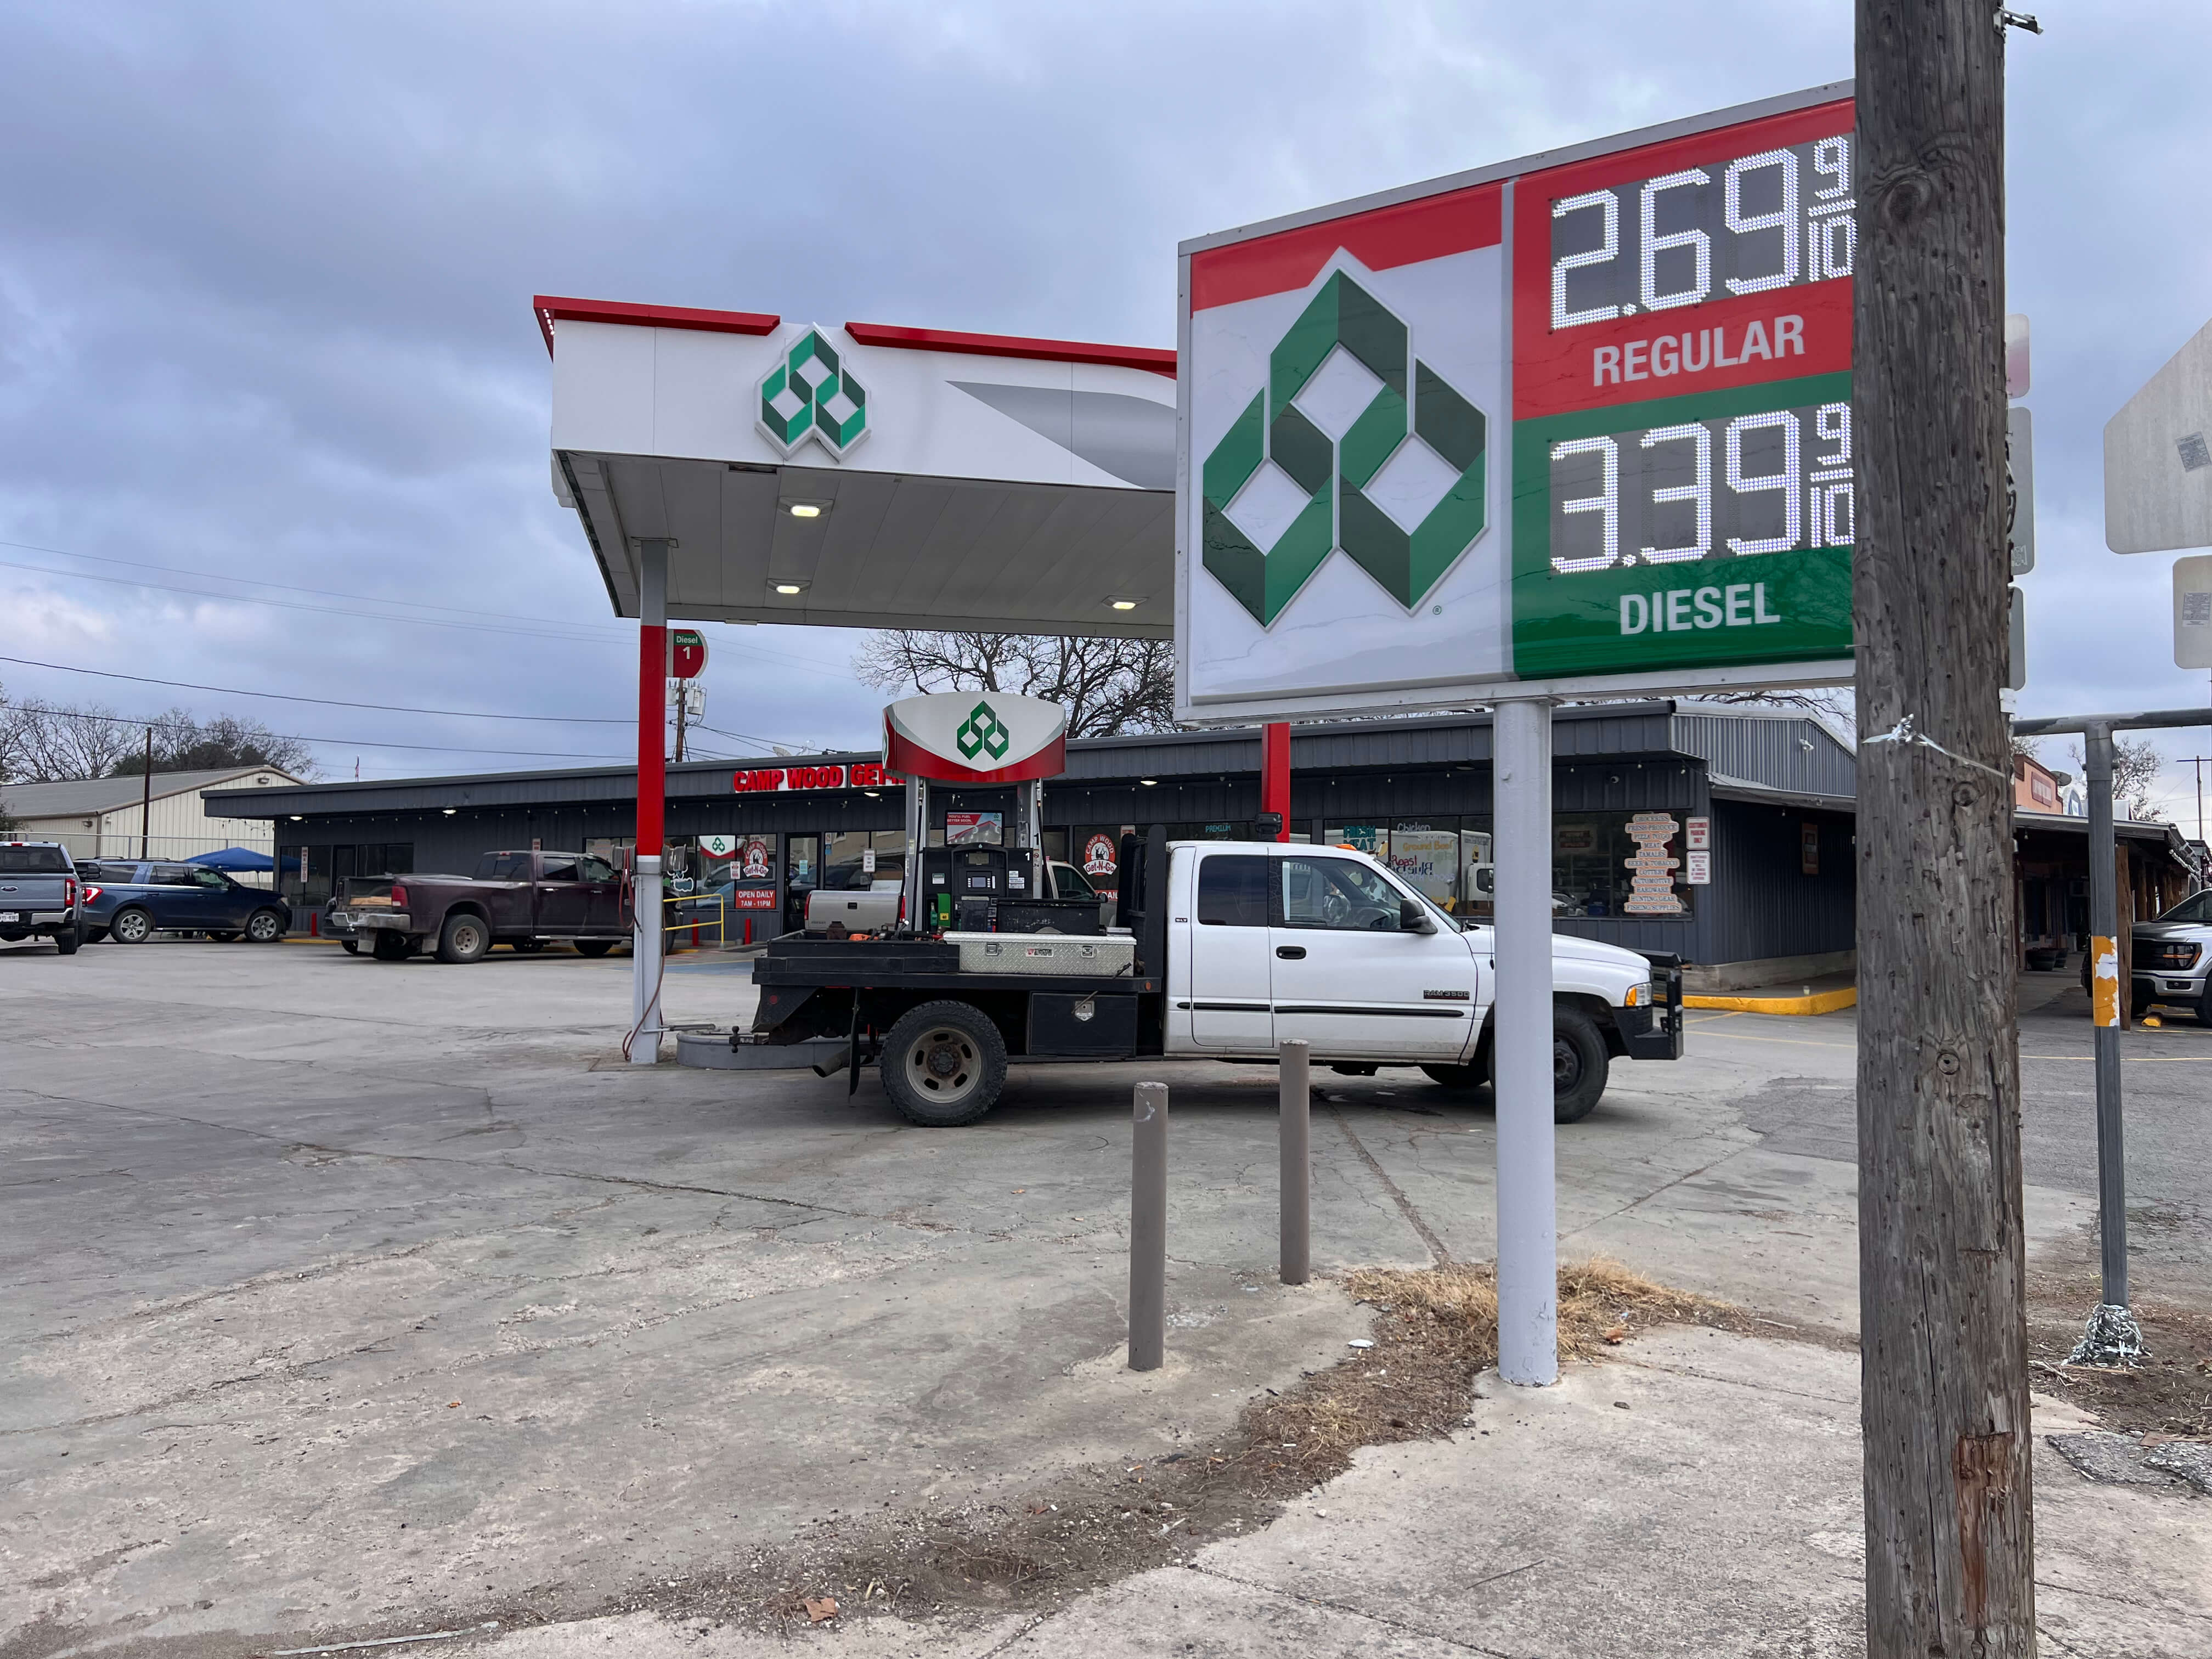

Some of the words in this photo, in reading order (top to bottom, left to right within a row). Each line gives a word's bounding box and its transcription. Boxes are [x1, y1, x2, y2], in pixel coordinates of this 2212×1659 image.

[1551, 147, 1801, 331] 2.69
[1593, 314, 1806, 387] REGULAR
[1550, 408, 1801, 575] 3.39
[1619, 582, 1781, 635] DIESEL
[676, 635, 698, 644] Diesel
[682, 646, 691, 659] 1
[733, 769, 785, 792] CAMP
[786, 766, 844, 789] WOOD
[1205, 825, 1231, 833] PREMIUM
[1344, 826, 1376, 838] FRESH
[1397, 822, 1431, 833] Chicken
[1034, 832, 1039, 845] 1
[1086, 837, 1098, 854] CAMP
[1099, 835, 1115, 854] WOOD
[1344, 838, 1376, 850] MEAT
[1403, 842, 1432, 851] Ground
[1434, 839, 1454, 850] Beef
[1025, 852, 1030, 861] 1
[1392, 855, 1417, 866] Roast
[745, 865, 767, 875] Get-N-Go
[1086, 861, 1115, 872] Get-N-Go
